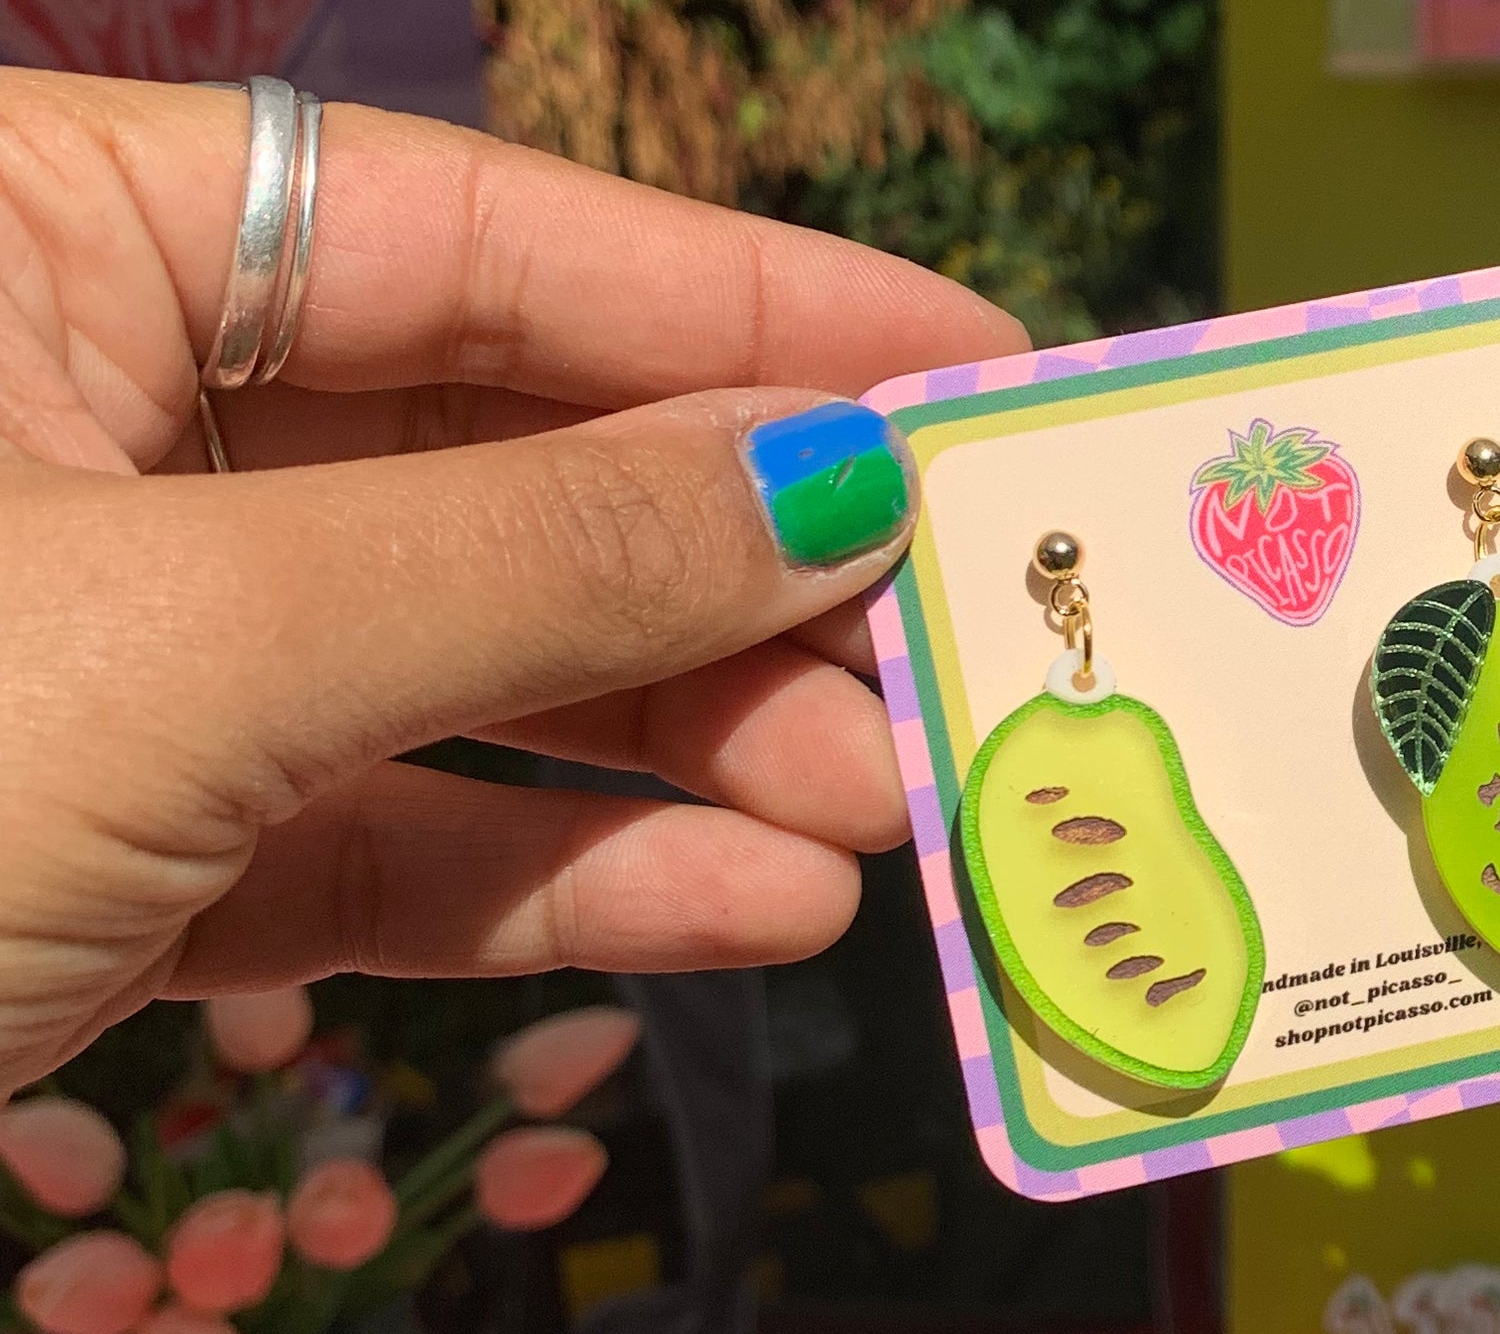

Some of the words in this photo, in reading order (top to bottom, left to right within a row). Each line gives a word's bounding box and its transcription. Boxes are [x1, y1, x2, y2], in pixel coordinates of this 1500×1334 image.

[1205, 481, 1351, 558] NOT
[1225, 522, 1350, 608] PICASSO
[1262, 963, 1346, 994] ndmade
[1349, 957, 1371, 975] in
[1375, 933, 1482, 969] Louisville,
[1294, 971, 1463, 1017] @not_picasso_
[1275, 989, 1493, 1048] shopnotpicasso.com
